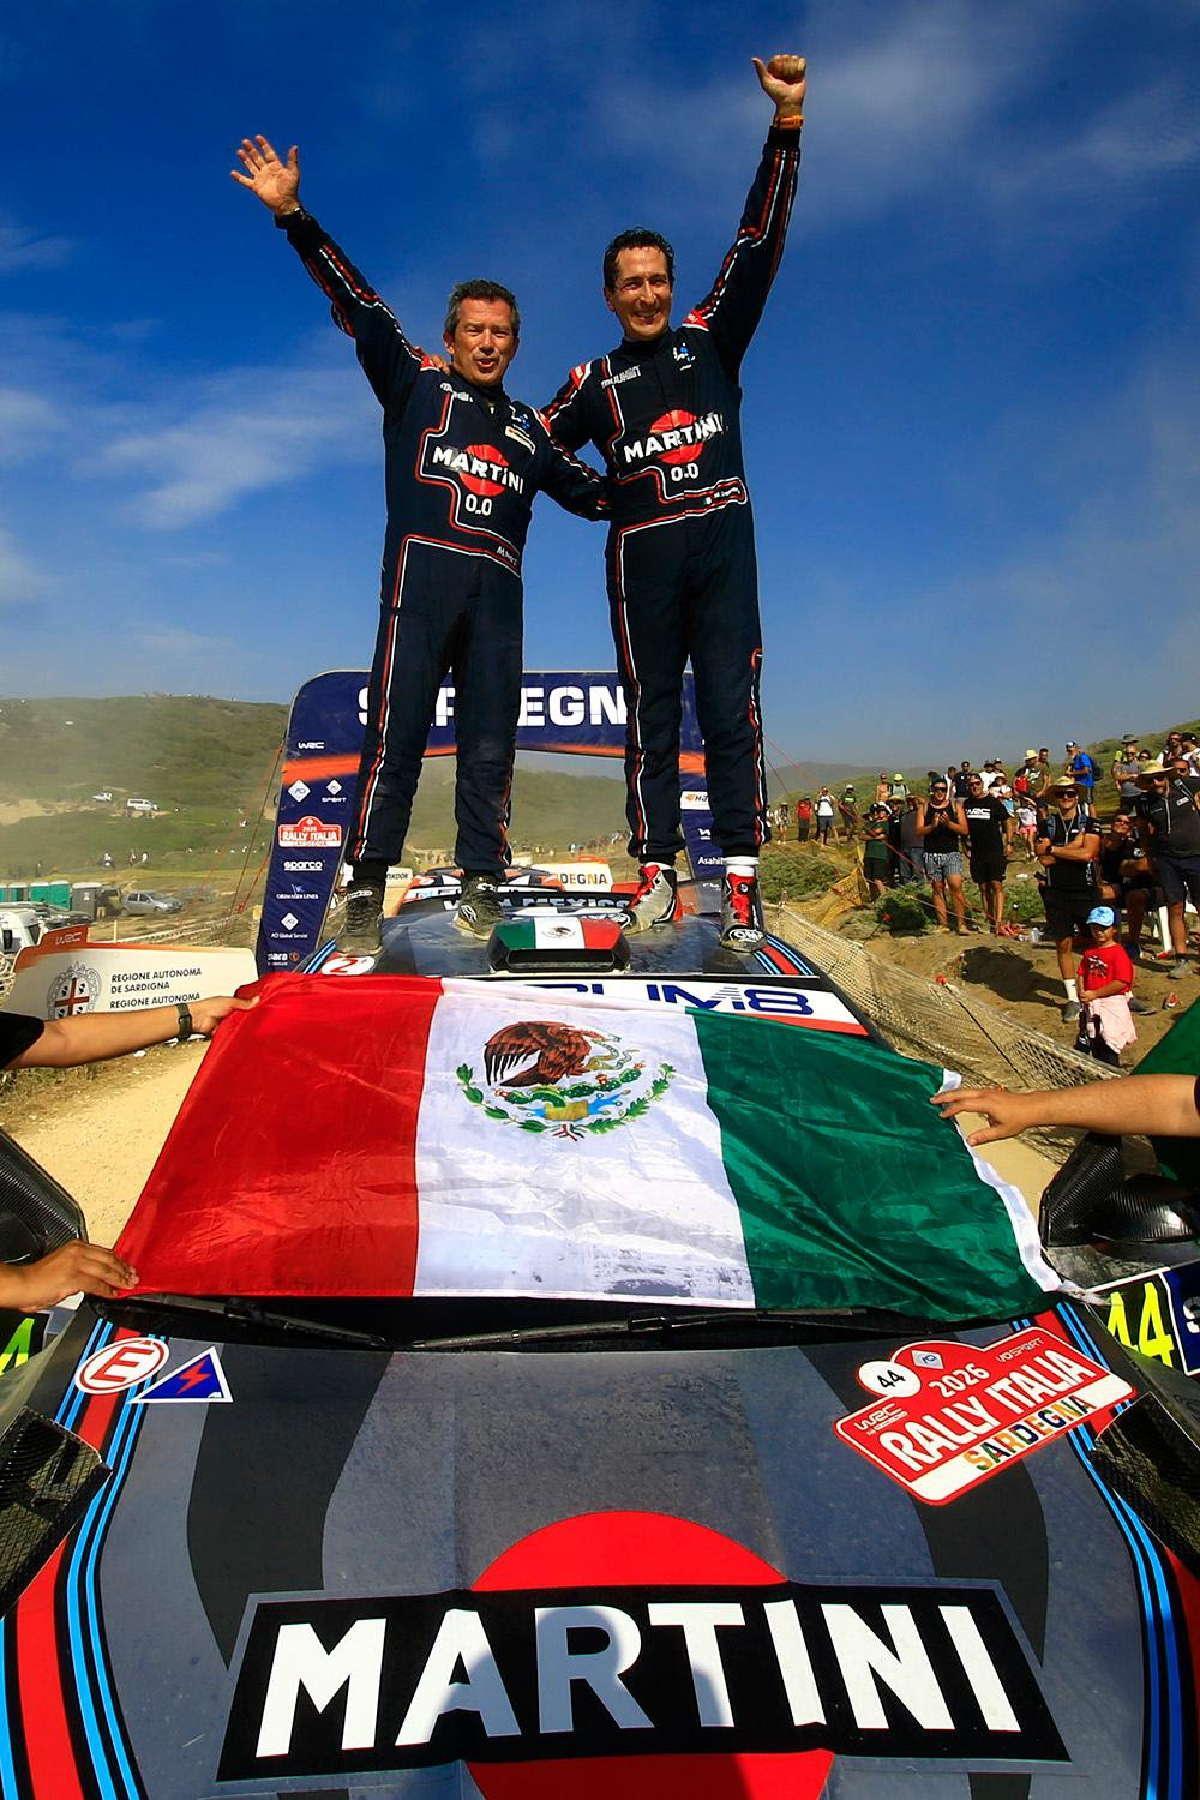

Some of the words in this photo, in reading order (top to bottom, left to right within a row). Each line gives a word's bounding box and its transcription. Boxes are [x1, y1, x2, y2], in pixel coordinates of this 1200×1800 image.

[623, 413, 723, 463] MARTINI
[432, 446, 524, 494] MARTINI
[671, 462, 698, 482] 0.0
[465, 493, 493, 516] 0.0
[283, 861, 323, 870] sparco
[111, 971, 150, 983] REGIONE
[152, 967, 202, 979] AUTONOMA
[111, 985, 122, 994] DE
[124, 981, 170, 993] SARDIGNA
[109, 997, 149, 1009] REGIONE
[151, 992, 201, 1004] AUTONOMA
[876, 1368, 905, 1389] 44
[928, 1362, 990, 1398] 2026
[853, 1402, 903, 1430] WRC
[879, 1395, 1000, 1472] RALLY
[984, 1349, 1097, 1415] ITALIA
[961, 1395, 1098, 1472] SARDEGNA
[255, 1601, 1022, 1759] MARTINI
